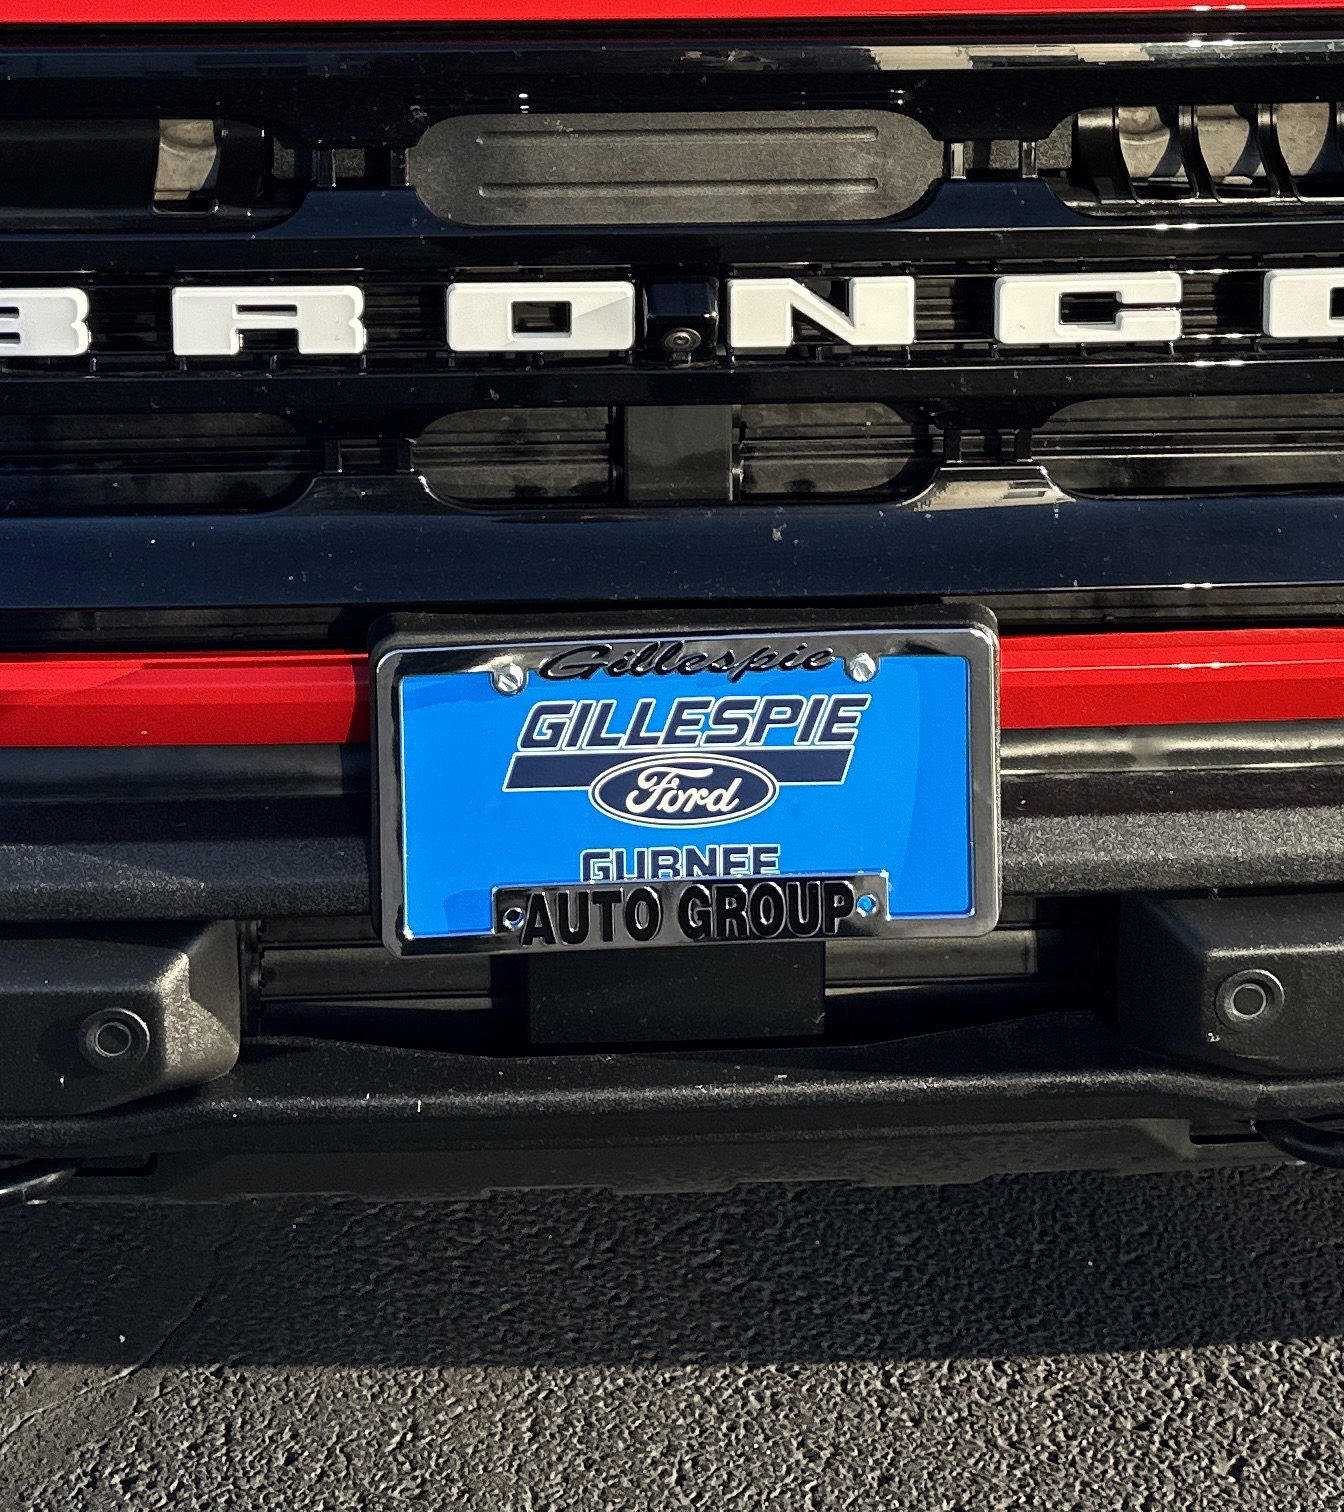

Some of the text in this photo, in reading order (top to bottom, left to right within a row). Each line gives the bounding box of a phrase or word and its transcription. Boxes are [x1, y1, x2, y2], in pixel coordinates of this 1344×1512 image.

[538, 641, 836, 684] Gillespie
[518, 695, 872, 750] GILLESPIE
[624, 765, 745, 816] Ford
[580, 843, 781, 882] GURNEE
[521, 879, 859, 947] AUTO GROUP
